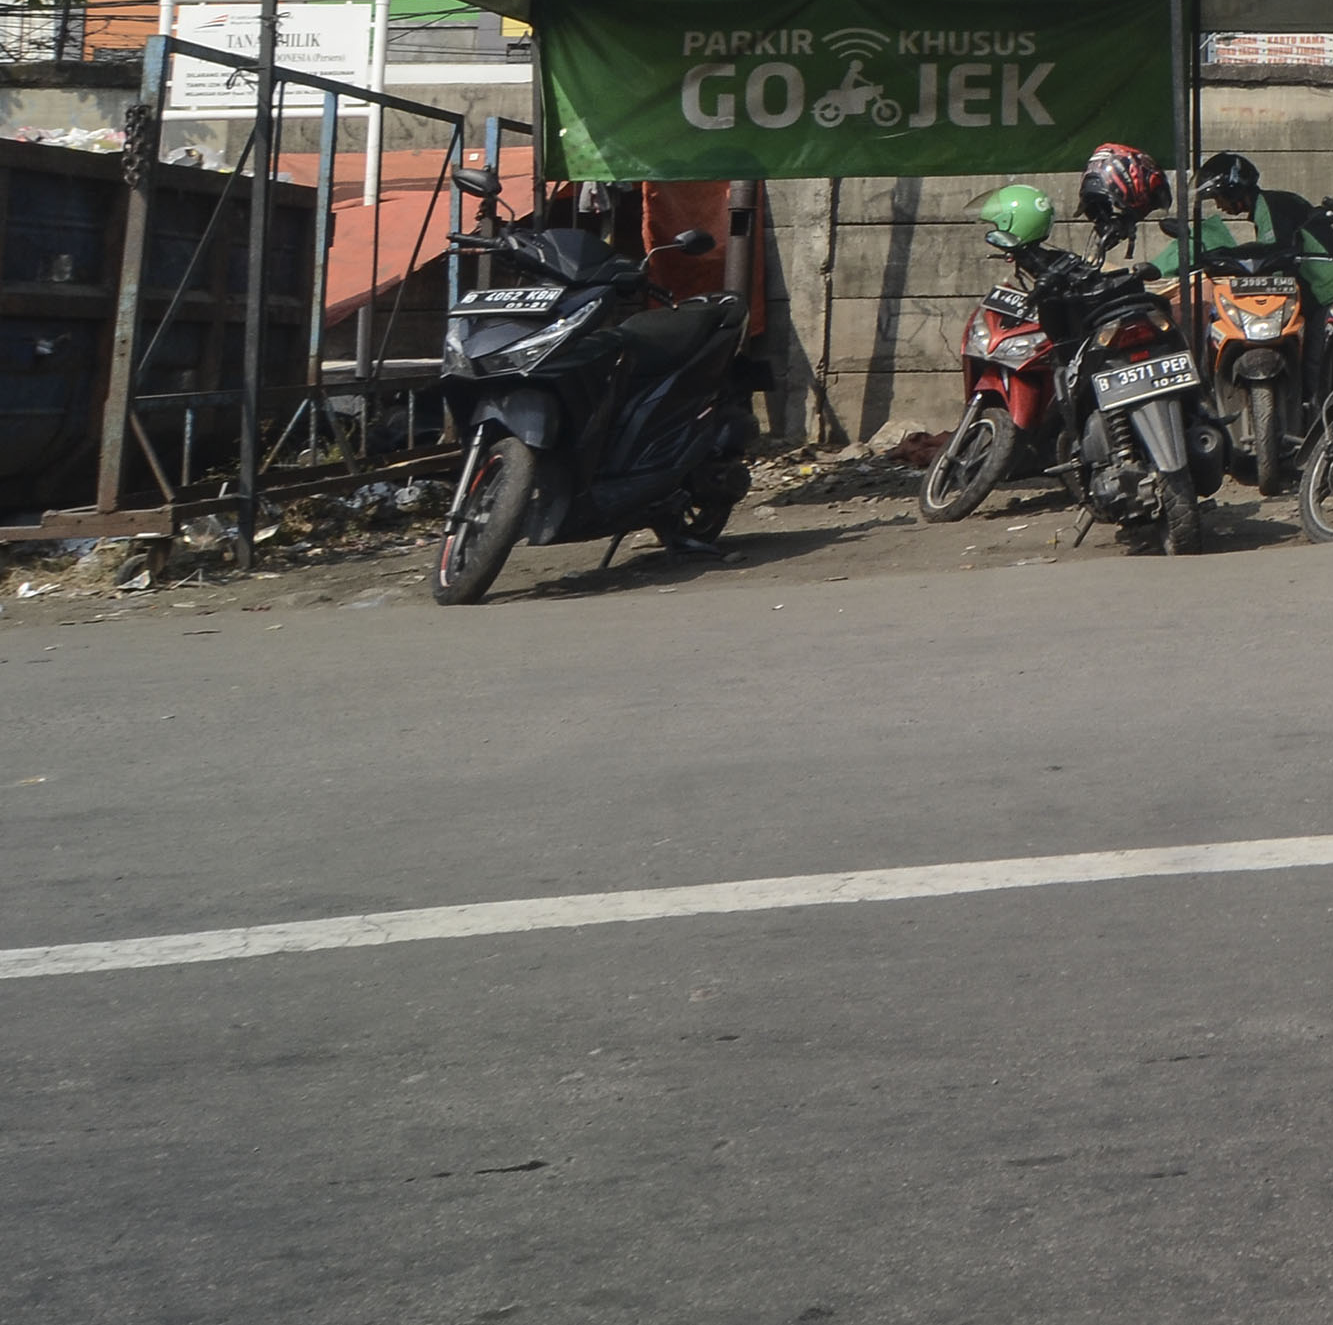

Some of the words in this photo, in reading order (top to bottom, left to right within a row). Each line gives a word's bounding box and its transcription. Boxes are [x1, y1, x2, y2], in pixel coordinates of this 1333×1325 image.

[681, 28, 814, 56] PARKIR
[898, 29, 1036, 56] KHUSUS
[1300, 35, 1325, 44] NAMA
[680, 60, 806, 131] GO
[909, 61, 1056, 128] JEK
[1098, 377, 1110, 392] B
[1118, 364, 1155, 386] 3571
[1160, 356, 1188, 374] PEP
